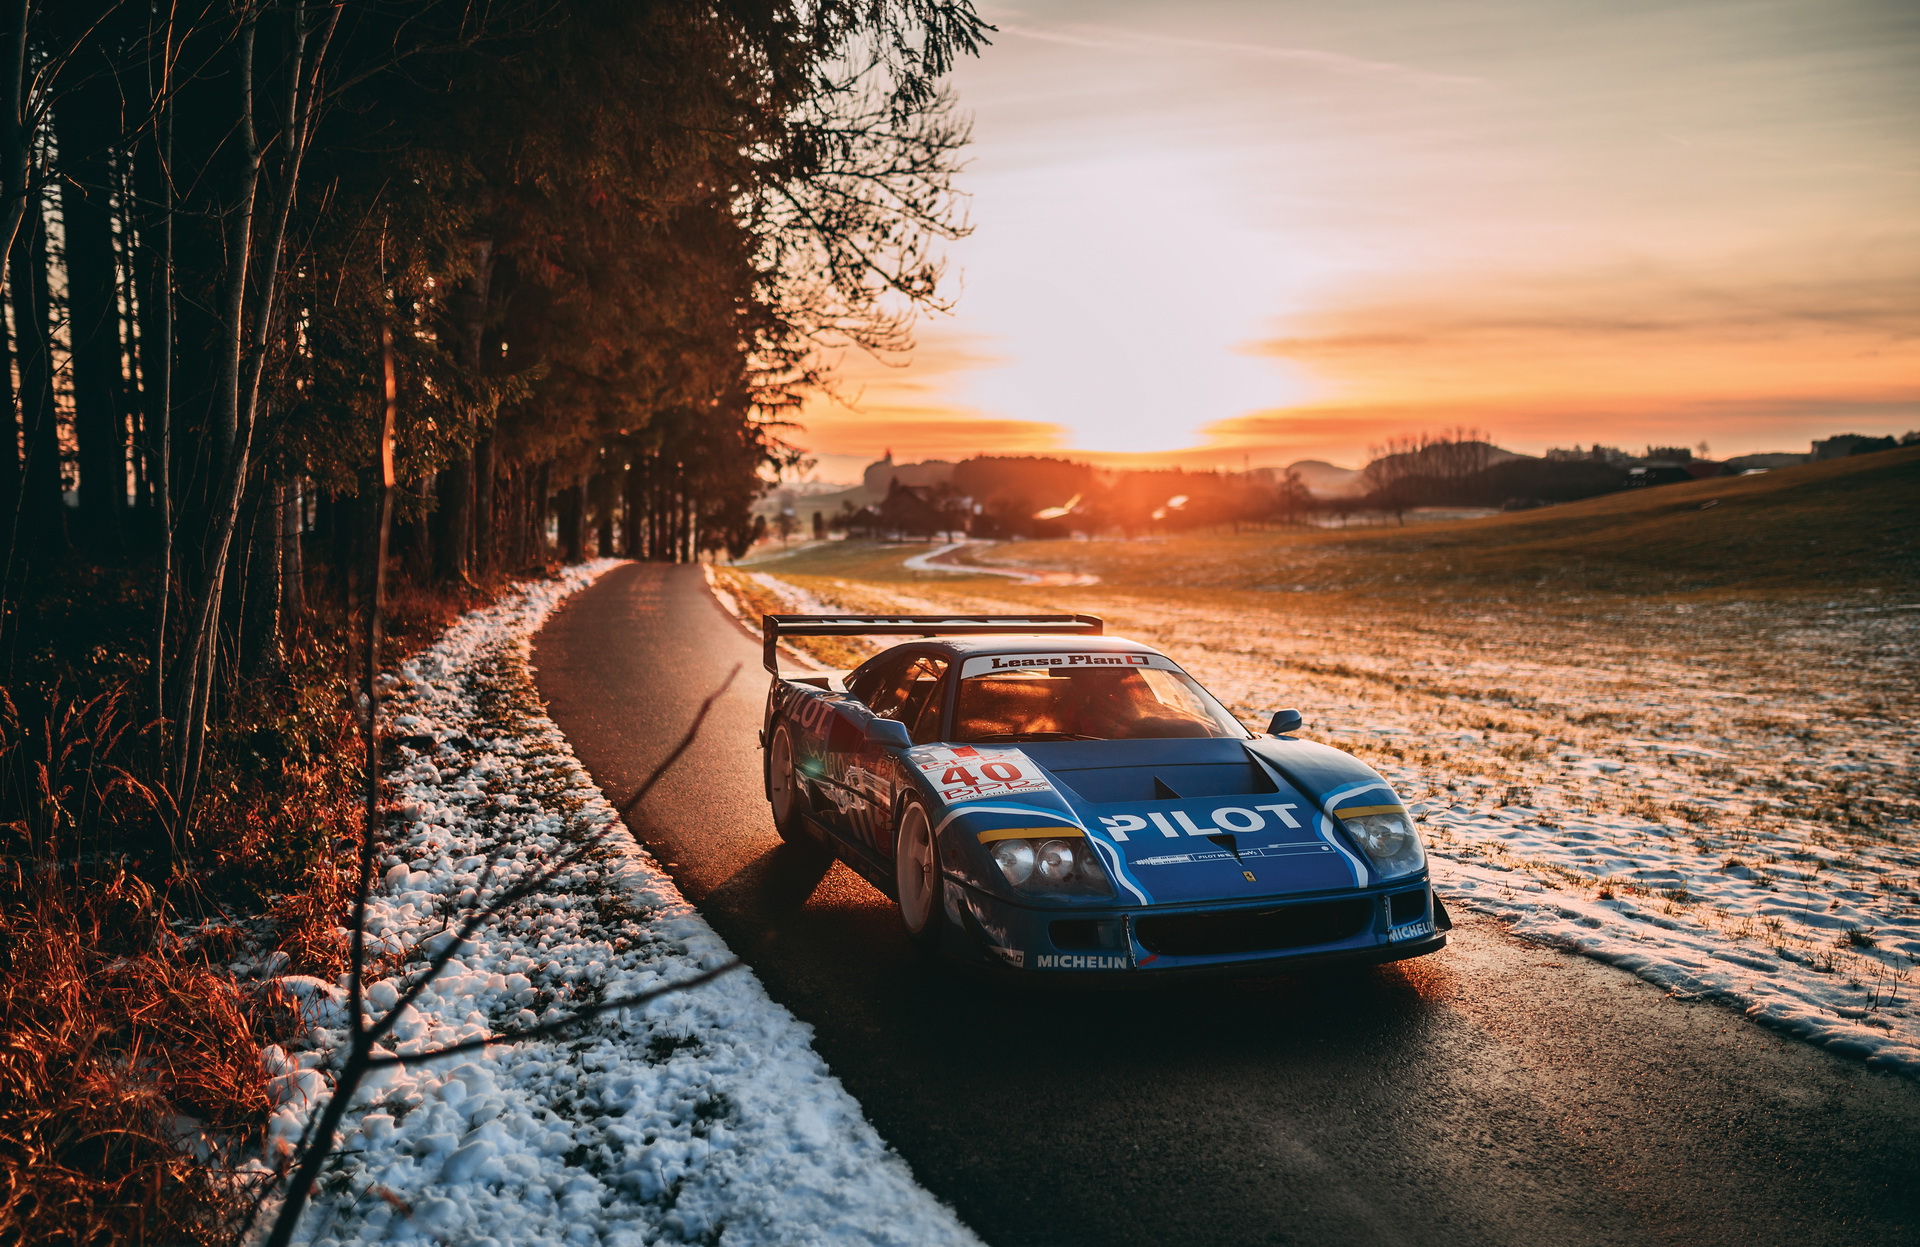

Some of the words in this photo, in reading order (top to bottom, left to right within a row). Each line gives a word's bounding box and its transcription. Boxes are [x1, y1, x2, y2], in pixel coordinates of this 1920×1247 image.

[991, 657, 1063, 669] Lease
[1067, 655, 1123, 665] Plan
[941, 762, 1022, 787] 40
[943, 780, 1048, 800] BPR
[1098, 803, 1302, 842] PILOT
[1389, 921, 1436, 941] MICHELIN
[1037, 955, 1127, 969] MICHELIN
